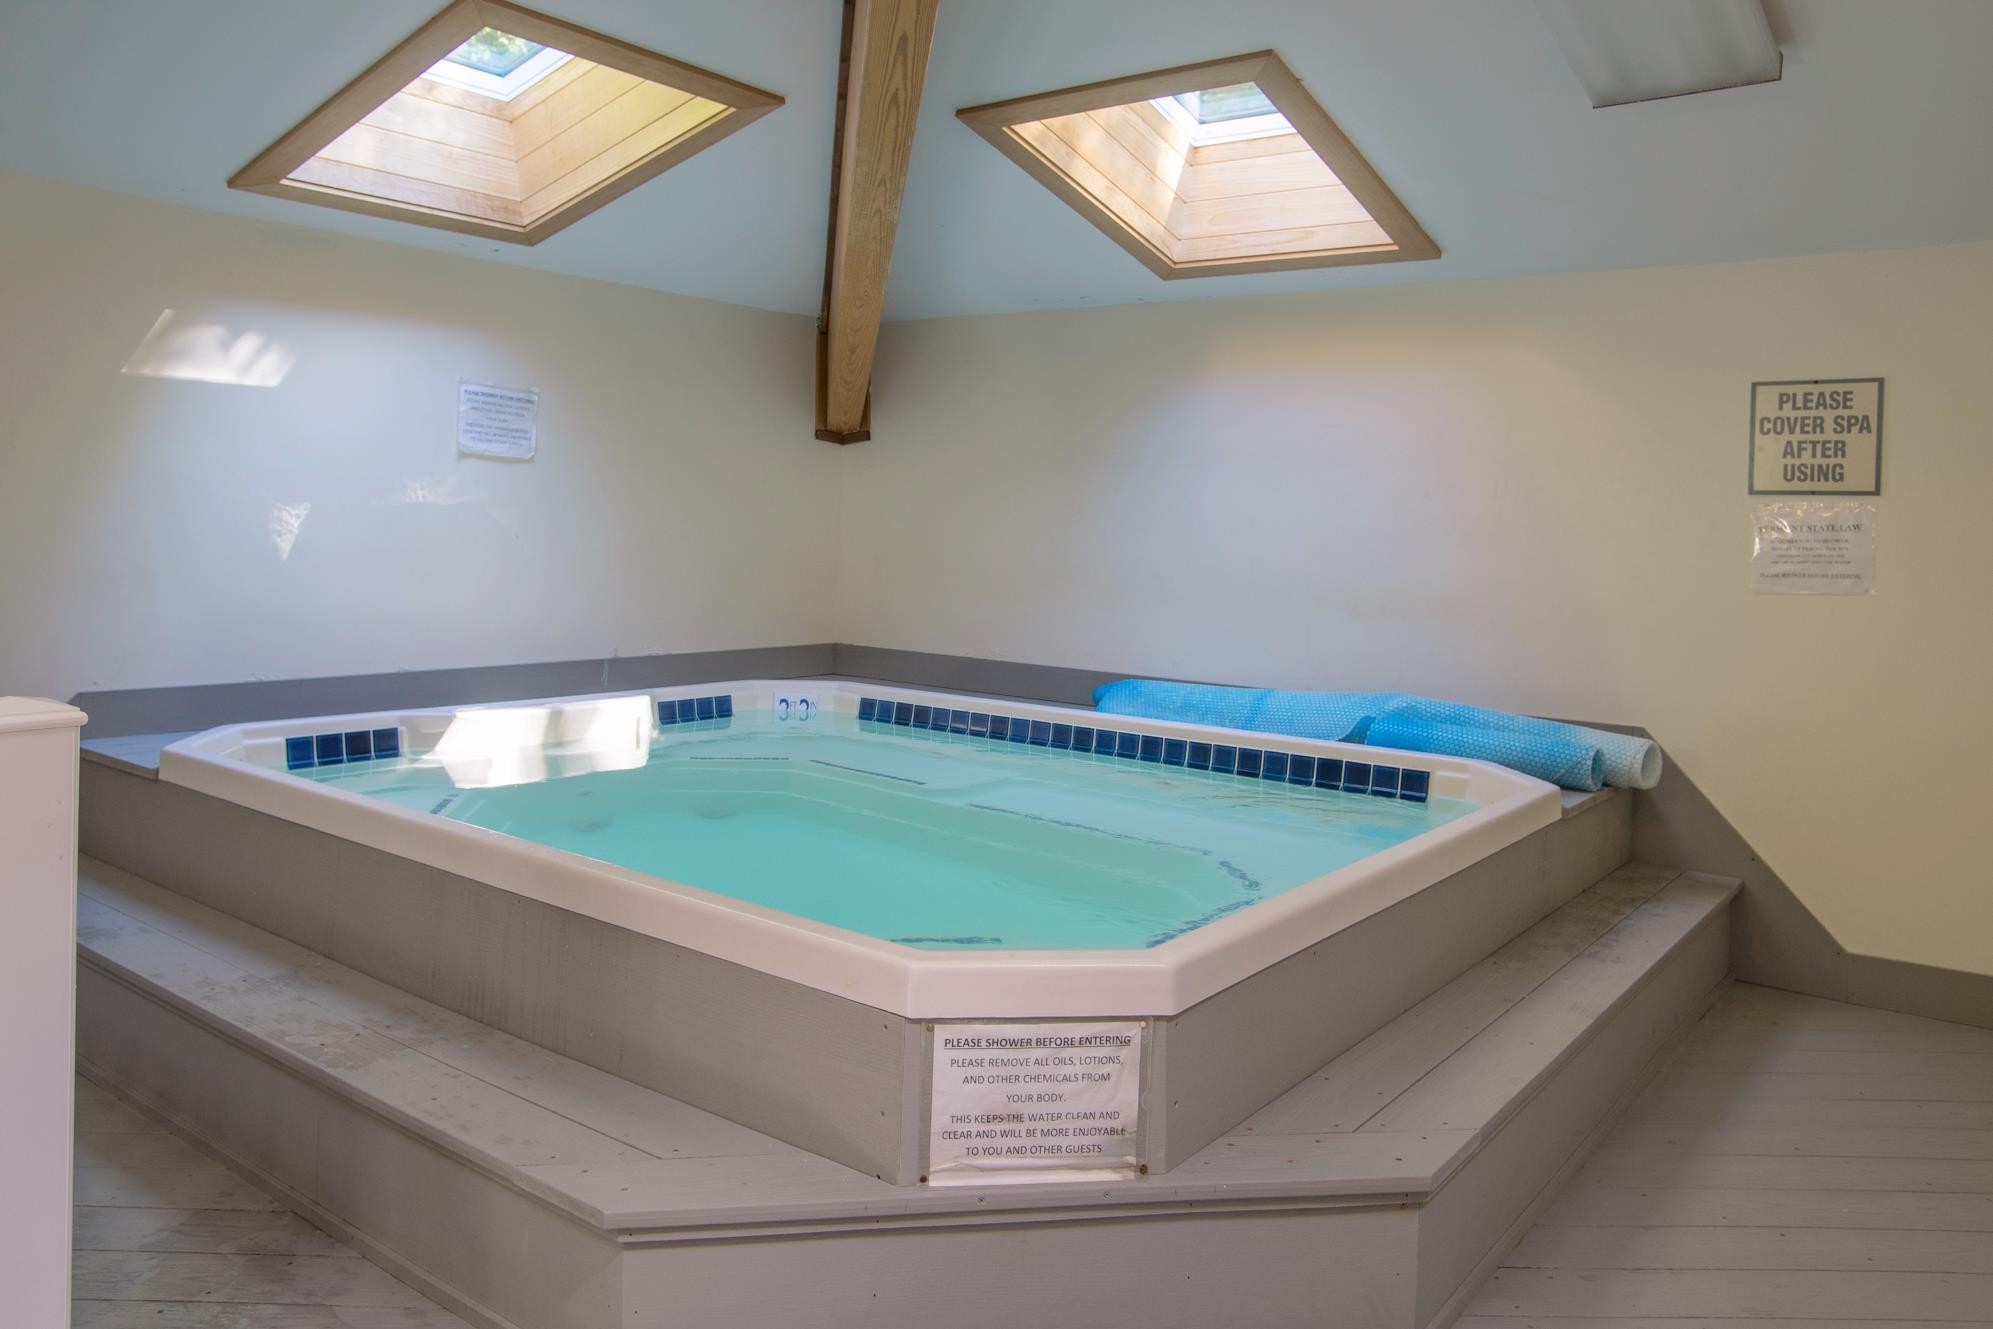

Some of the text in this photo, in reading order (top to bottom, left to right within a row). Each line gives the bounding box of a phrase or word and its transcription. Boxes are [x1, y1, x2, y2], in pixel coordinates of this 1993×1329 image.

[1778, 391, 1854, 411] PLEASE
[1759, 415, 1872, 435] COVER SPA
[1782, 440, 1846, 459] AFTER
[1783, 464, 1845, 483] USING
[945, 1035, 1131, 1048] PLEASE SHOWER BEFORE ENTERING
[951, 1056, 1123, 1068] PLEASE REMOVE ALL OILS, LOTIONS,
[963, 1073, 1110, 1085] AND OTHER CHEMICALS FROM
[1007, 1093, 1066, 1103] YOUR BODY.
[951, 1111, 1120, 1124] THIS KEEPS THE WATER CLEAN AND
[942, 1127, 1126, 1140] CLEAR AND WILL BE MORE ENJOYABLE
[966, 1144, 1102, 1156] TO YOU AND OTHER GUESTS
